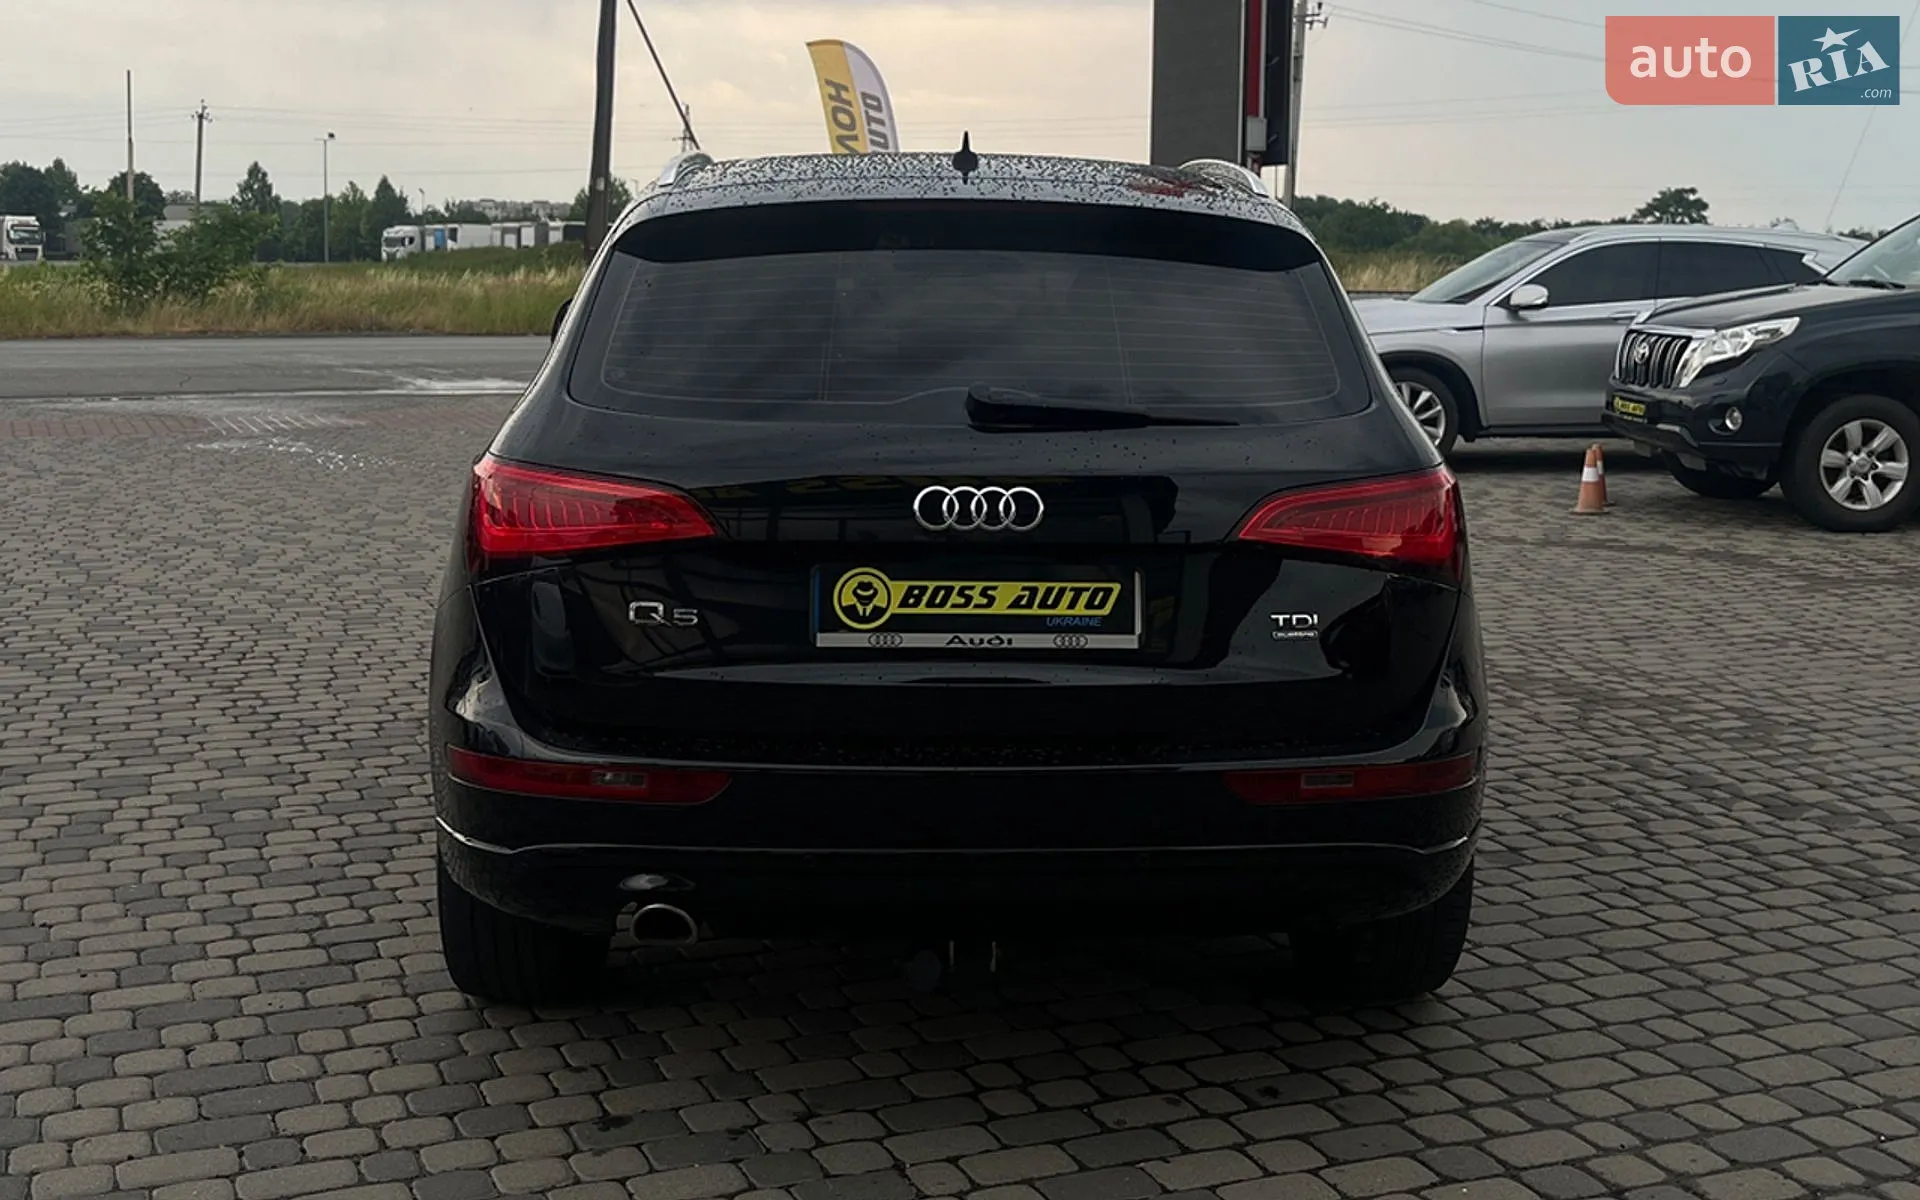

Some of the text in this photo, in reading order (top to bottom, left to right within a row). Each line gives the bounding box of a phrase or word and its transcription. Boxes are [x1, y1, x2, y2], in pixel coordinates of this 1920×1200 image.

[861, 91, 890, 152] UTO
[895, 584, 1113, 611] BOSS AUTO
[629, 601, 698, 627] Q5
[1046, 617, 1103, 627] UKRAINE
[1270, 613, 1318, 628] TDI
[944, 634, 1013, 647] Audi
